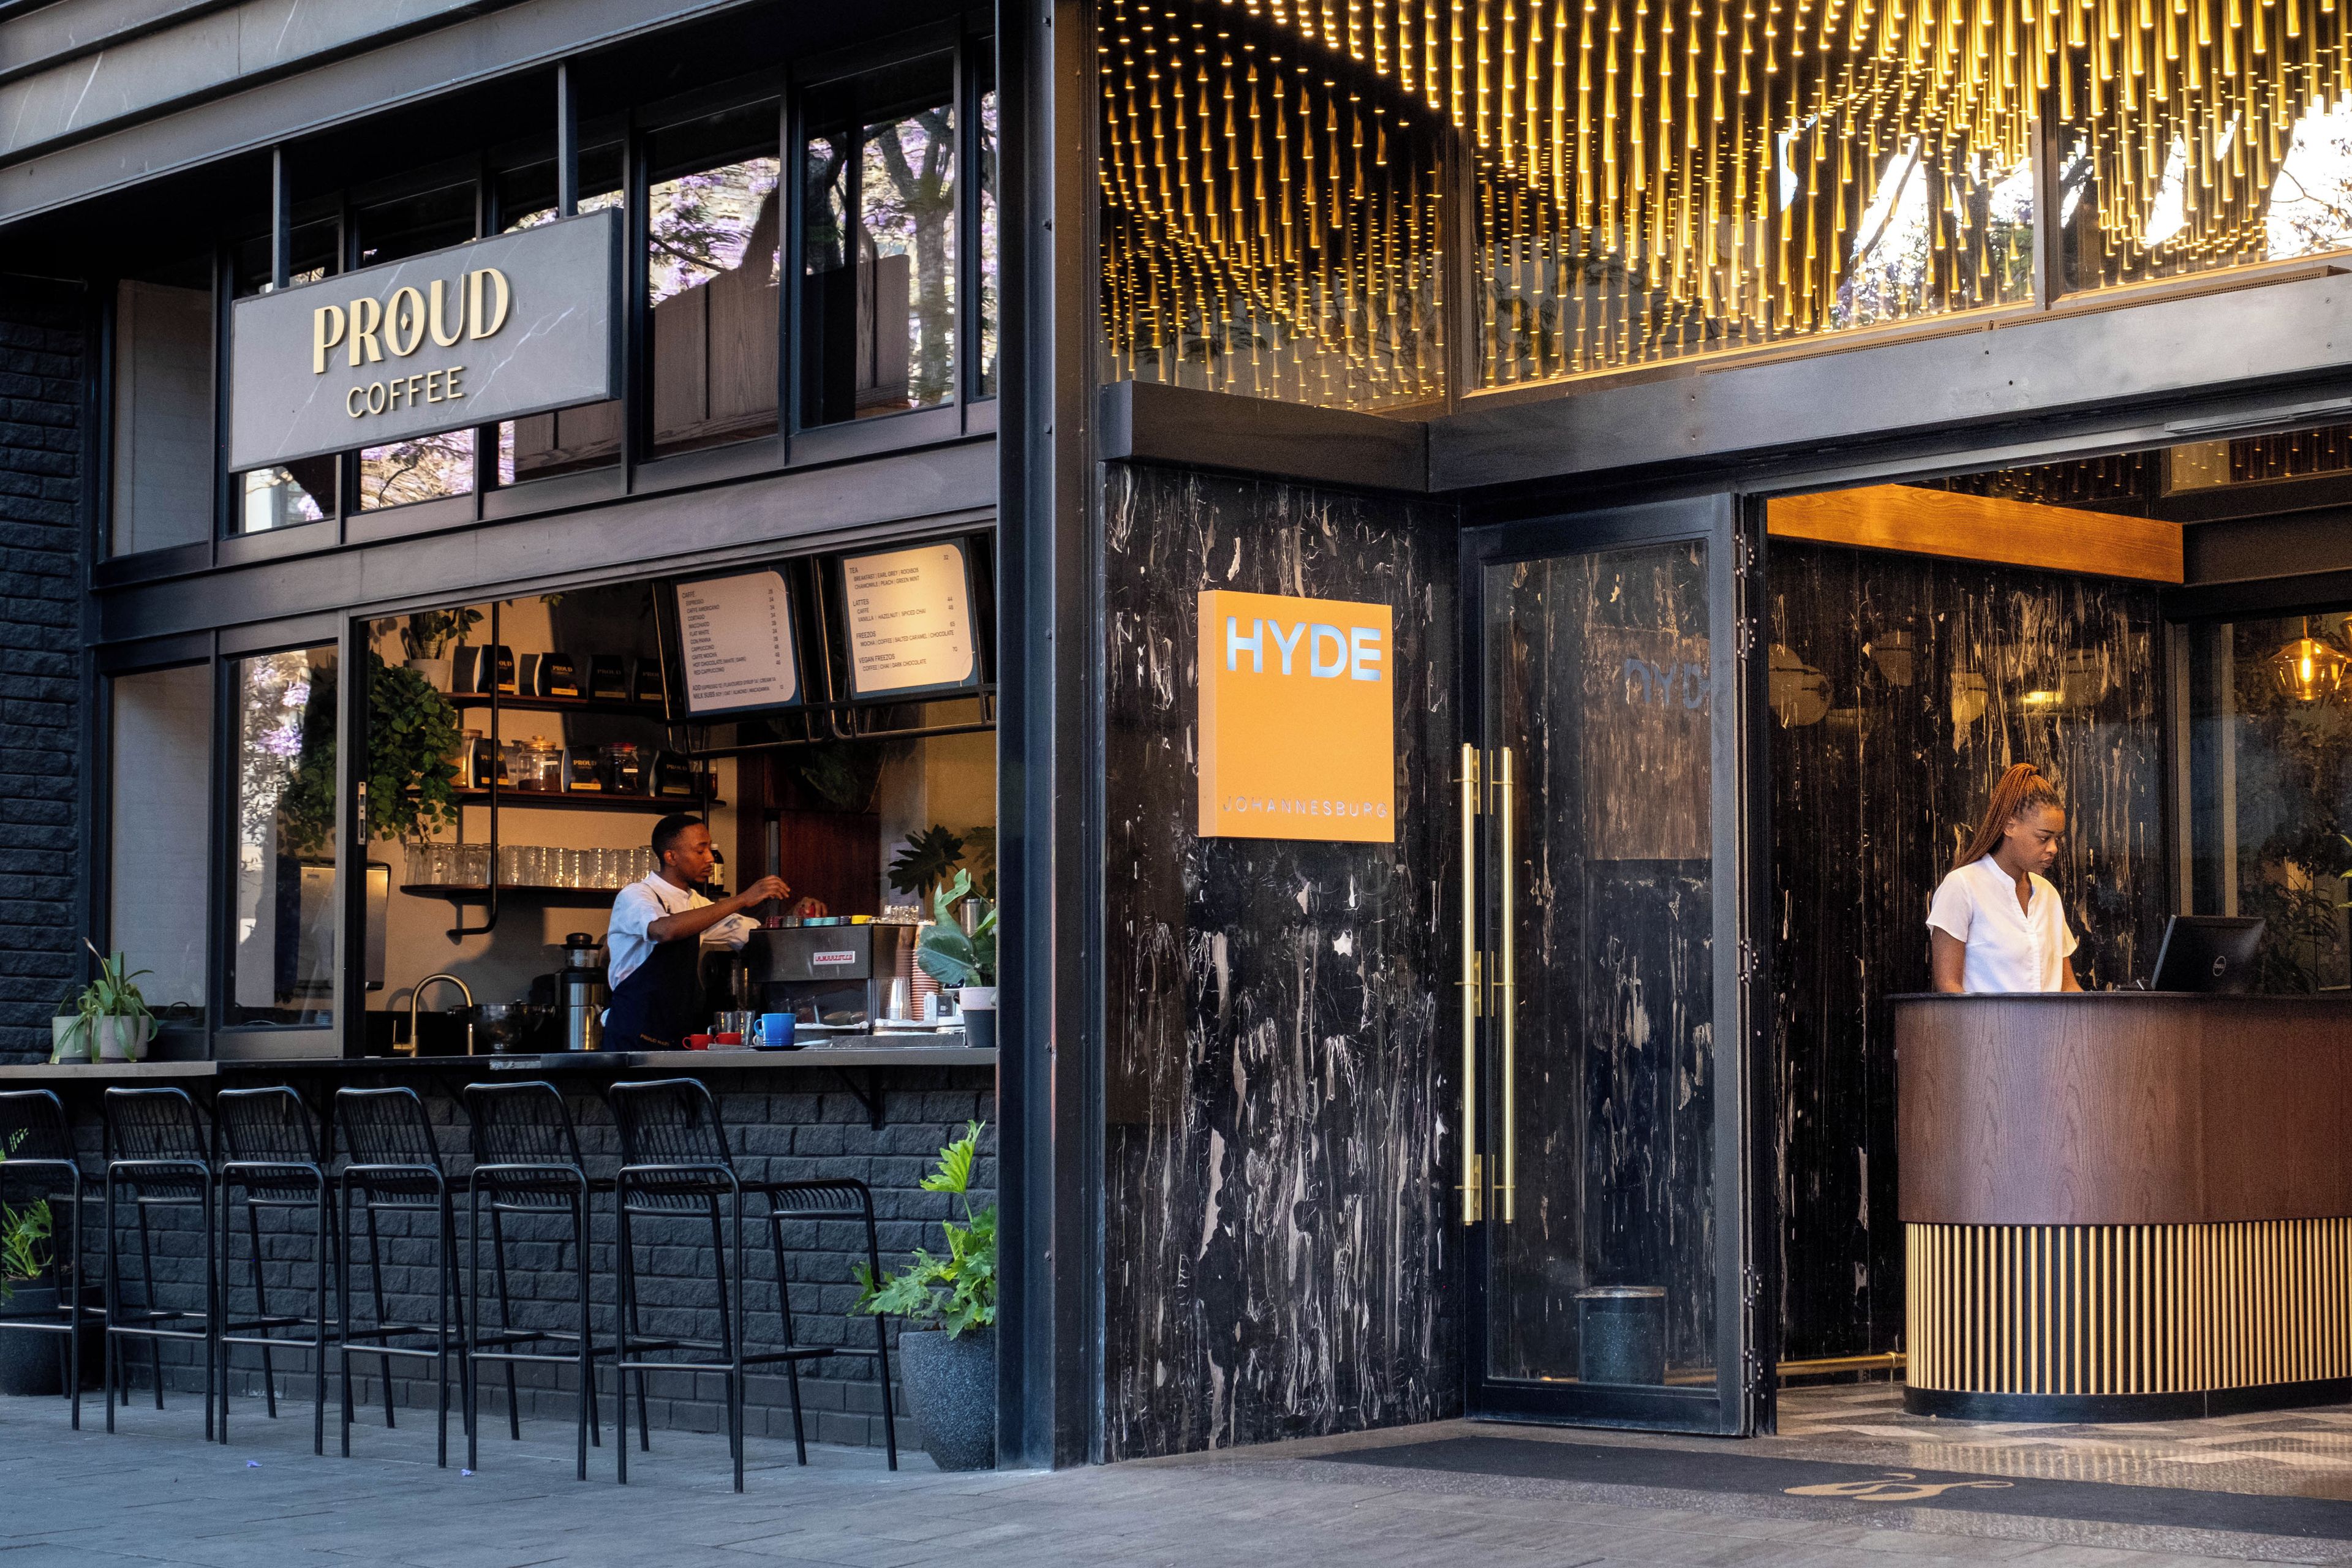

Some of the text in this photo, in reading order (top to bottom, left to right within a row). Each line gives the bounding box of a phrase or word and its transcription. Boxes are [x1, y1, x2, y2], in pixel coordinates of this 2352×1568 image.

[313, 268, 510, 374] PROUD
[347, 366, 466, 418] COFFEE
[1226, 616, 1382, 681] HYDE
[1223, 796, 1388, 818] JOHANNESBURG
